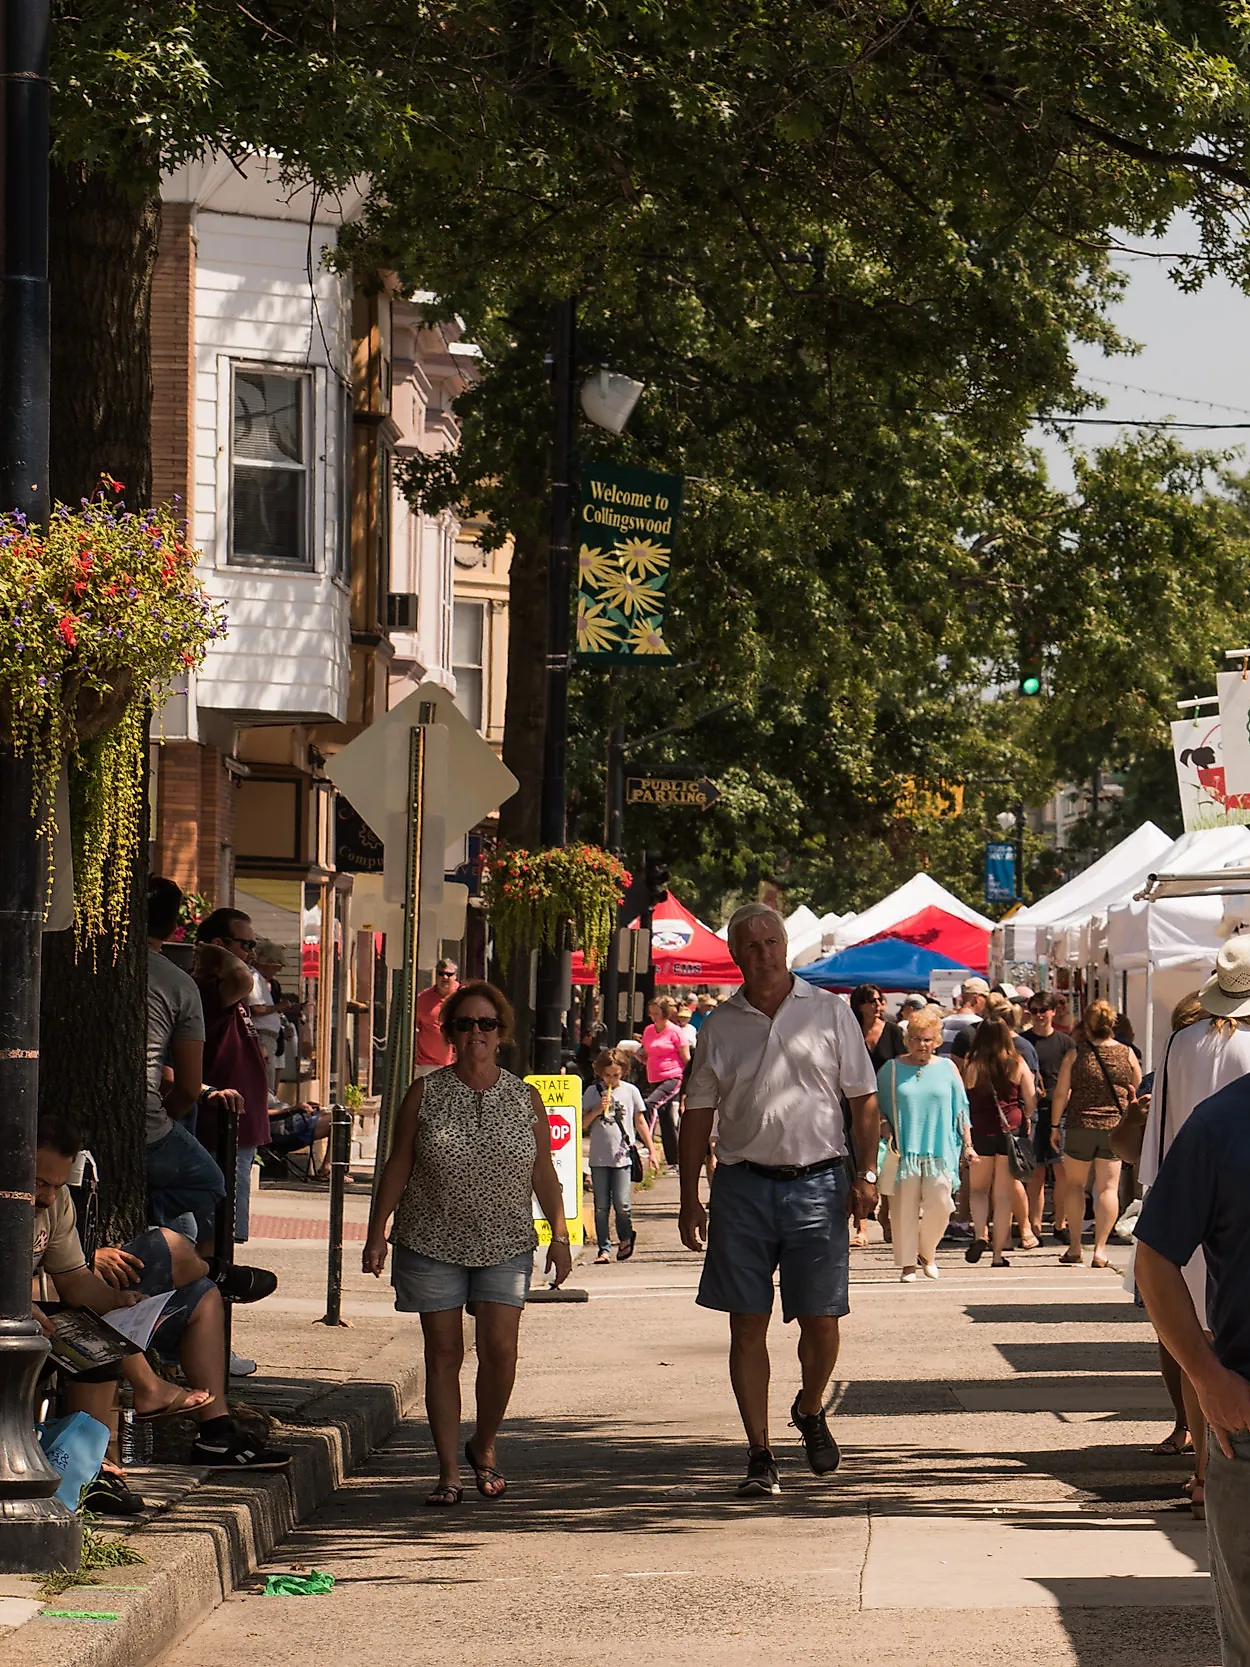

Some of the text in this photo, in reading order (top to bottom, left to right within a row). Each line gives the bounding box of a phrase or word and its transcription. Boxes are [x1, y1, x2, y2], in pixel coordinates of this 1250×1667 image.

[590, 480, 669, 511] Welcome to
[583, 504, 673, 535] Collingswood
[640, 779, 700, 793] PUBLIC
[632, 788, 707, 804] PARKING
[673, 962, 702, 975] EMS
[534, 1079, 570, 1090] STATE
[550, 1125, 570, 1140] OP
